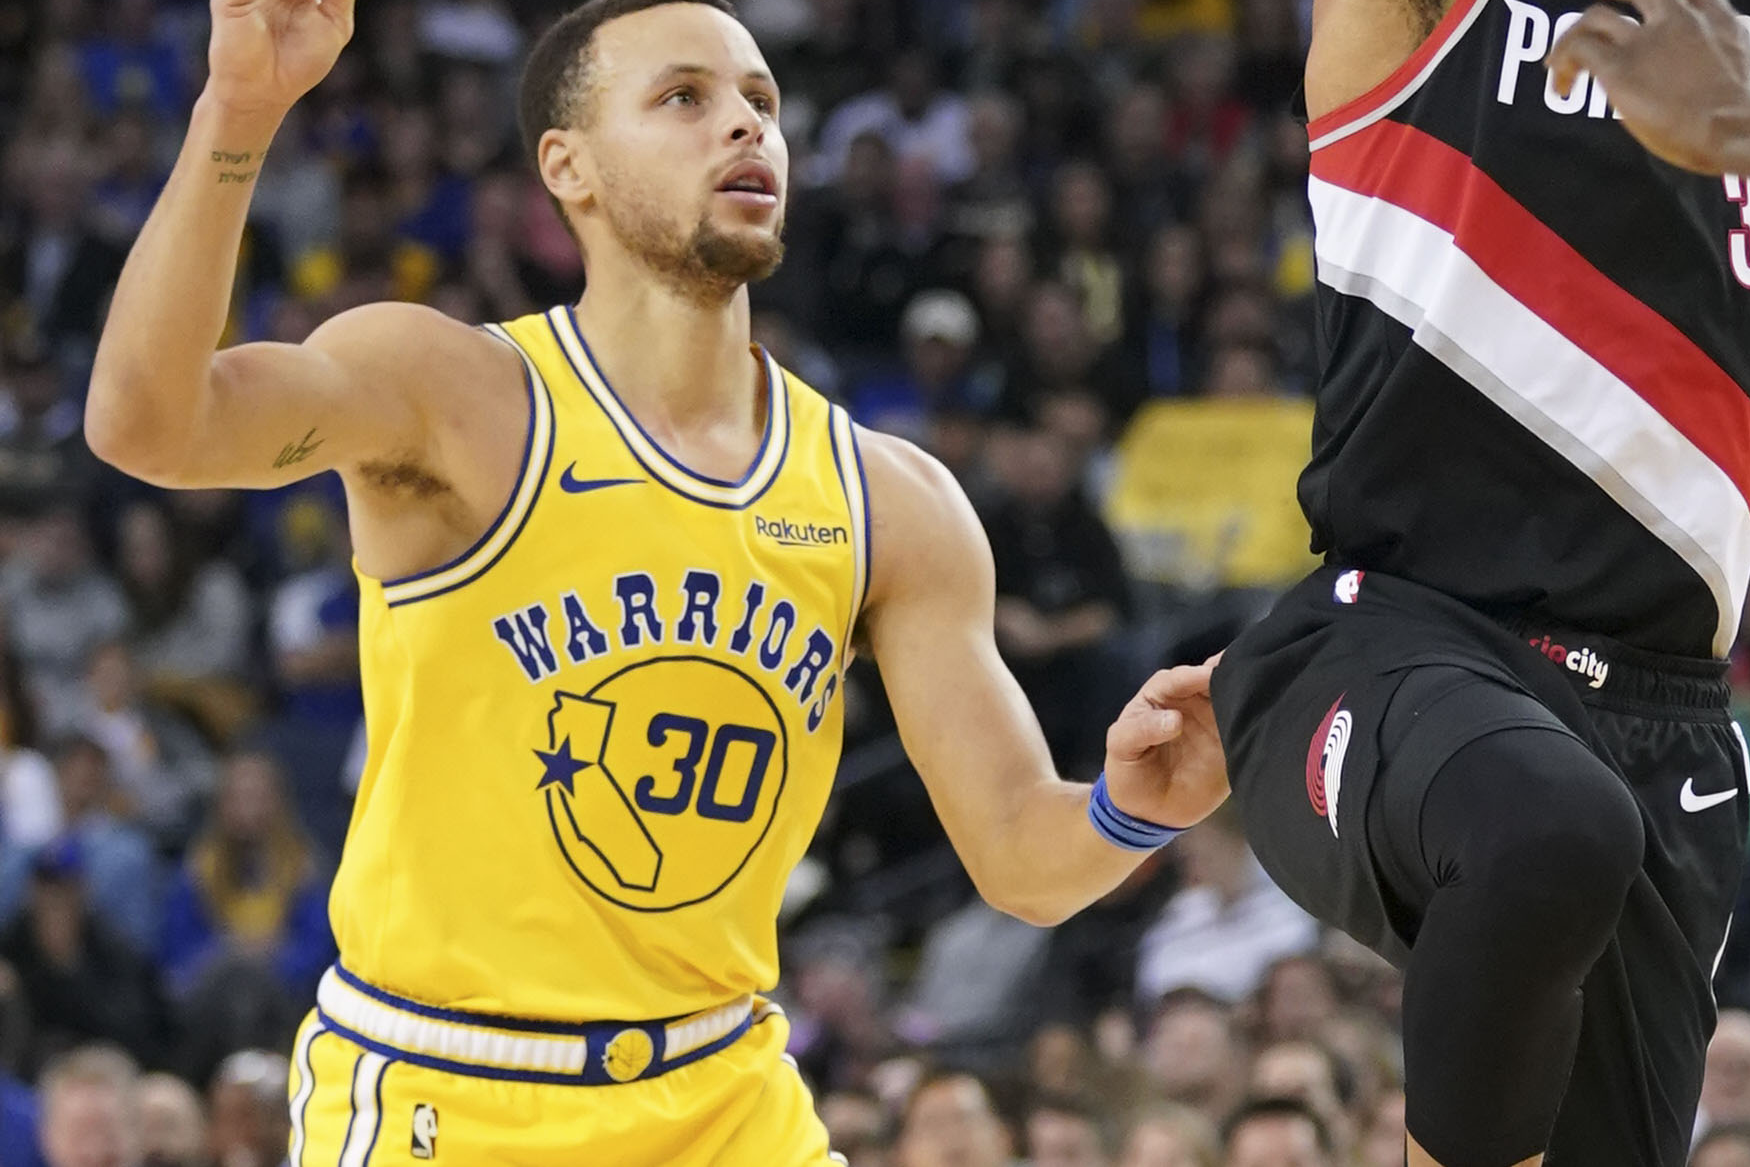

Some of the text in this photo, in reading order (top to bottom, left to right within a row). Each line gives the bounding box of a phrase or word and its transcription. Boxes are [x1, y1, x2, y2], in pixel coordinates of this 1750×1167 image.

[754, 514, 848, 546] Rakuten
[492, 569, 838, 734] WARRIORS
[634, 712, 777, 824] 30
